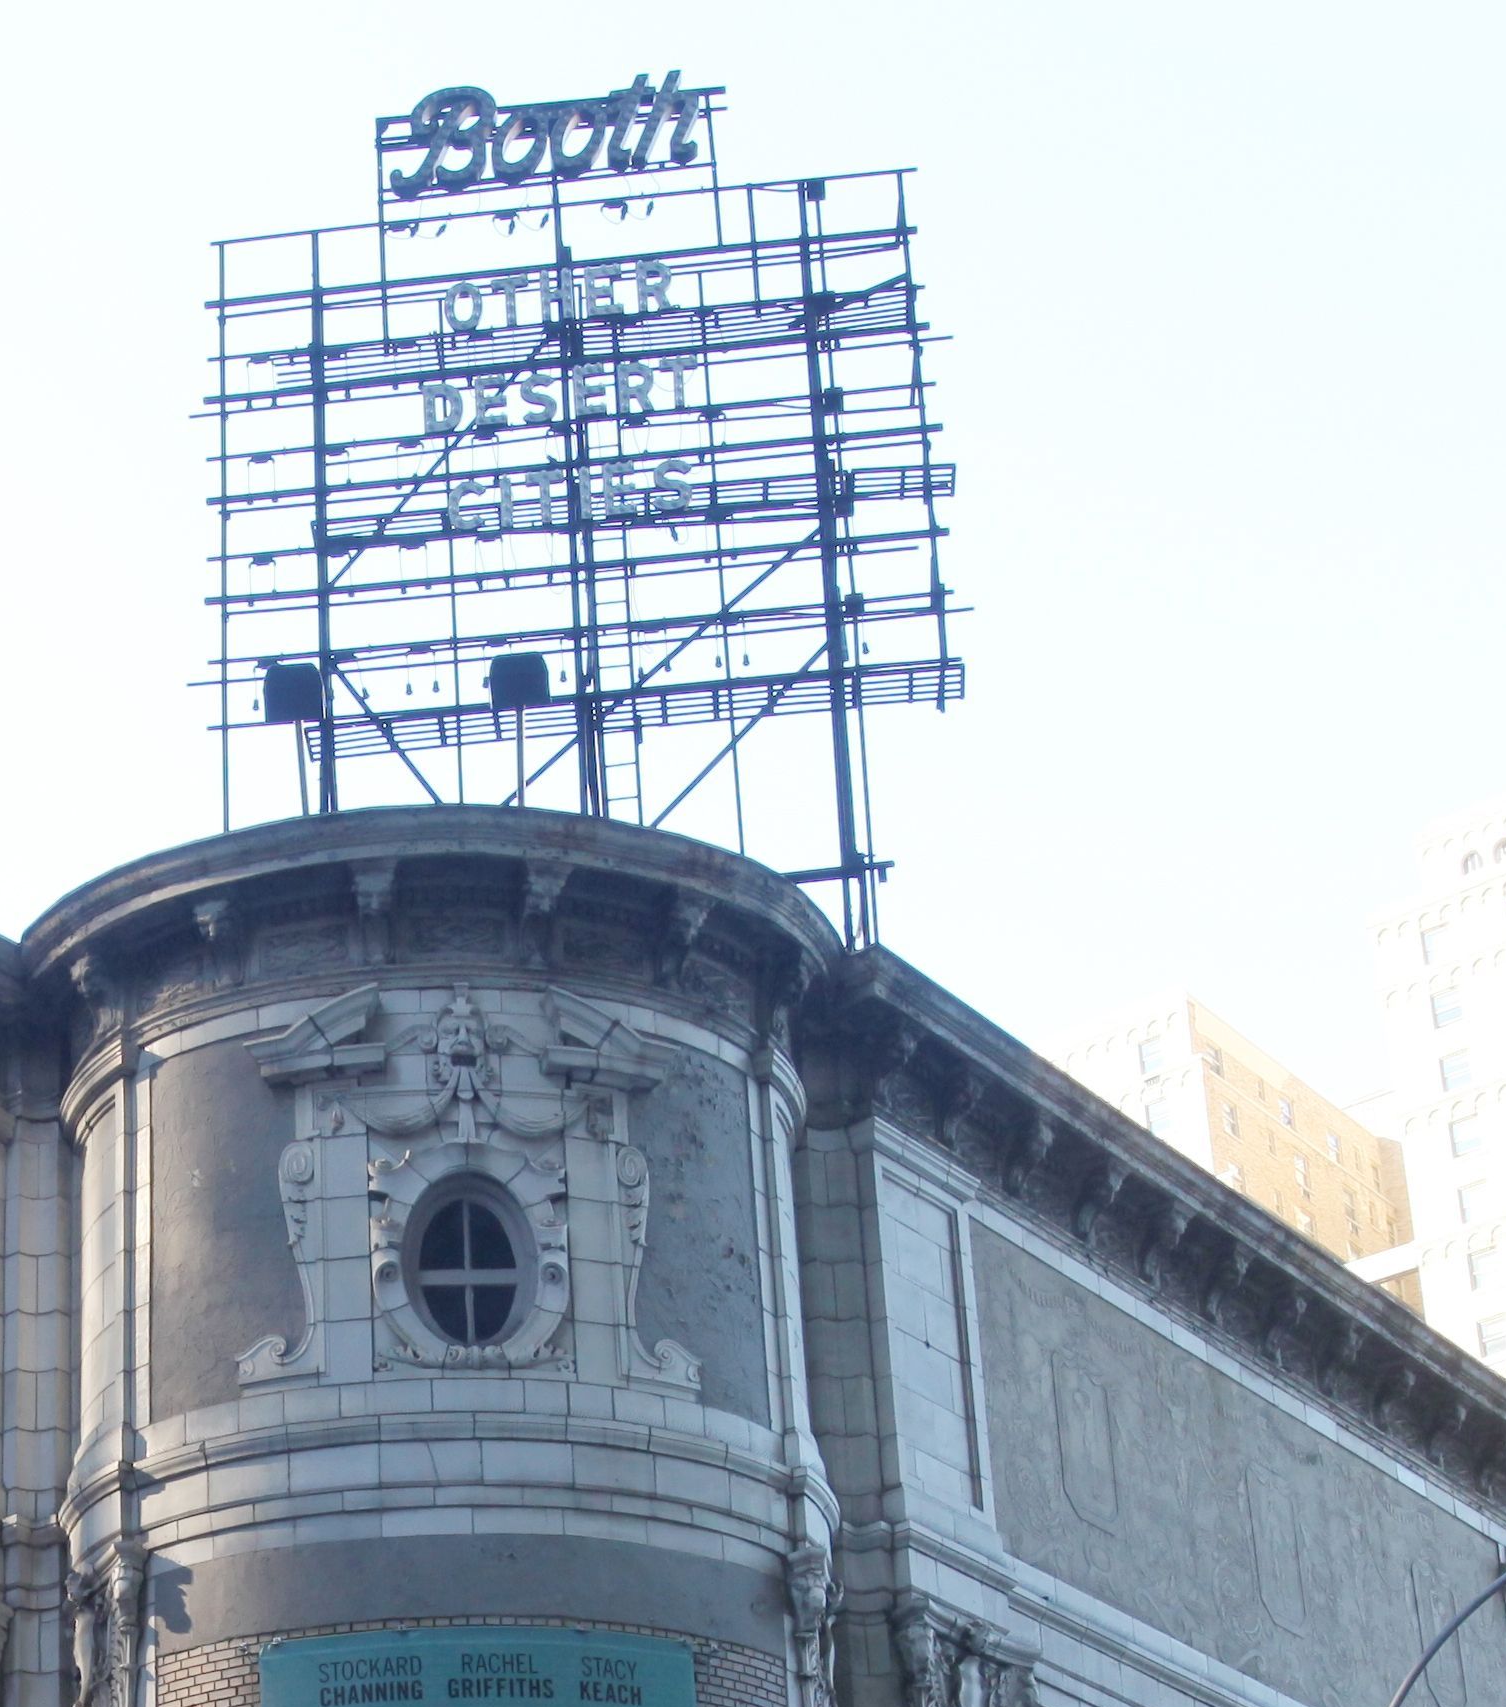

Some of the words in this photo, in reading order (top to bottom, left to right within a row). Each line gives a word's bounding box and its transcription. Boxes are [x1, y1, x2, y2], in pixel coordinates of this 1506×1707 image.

[390, 70, 700, 200] Booth
[444, 260, 676, 332] OTHER
[422, 356, 696, 434] DESERT
[448, 460, 694, 532] CITIES
[318, 1656, 423, 1684] STOCKARD
[461, 1653, 540, 1675] RACHEL
[581, 1656, 638, 1681] STACY
[320, 1680, 424, 1707] CHANNING
[447, 1677, 555, 1700] GRIFFITHS
[579, 1681, 643, 1706] KEACH
